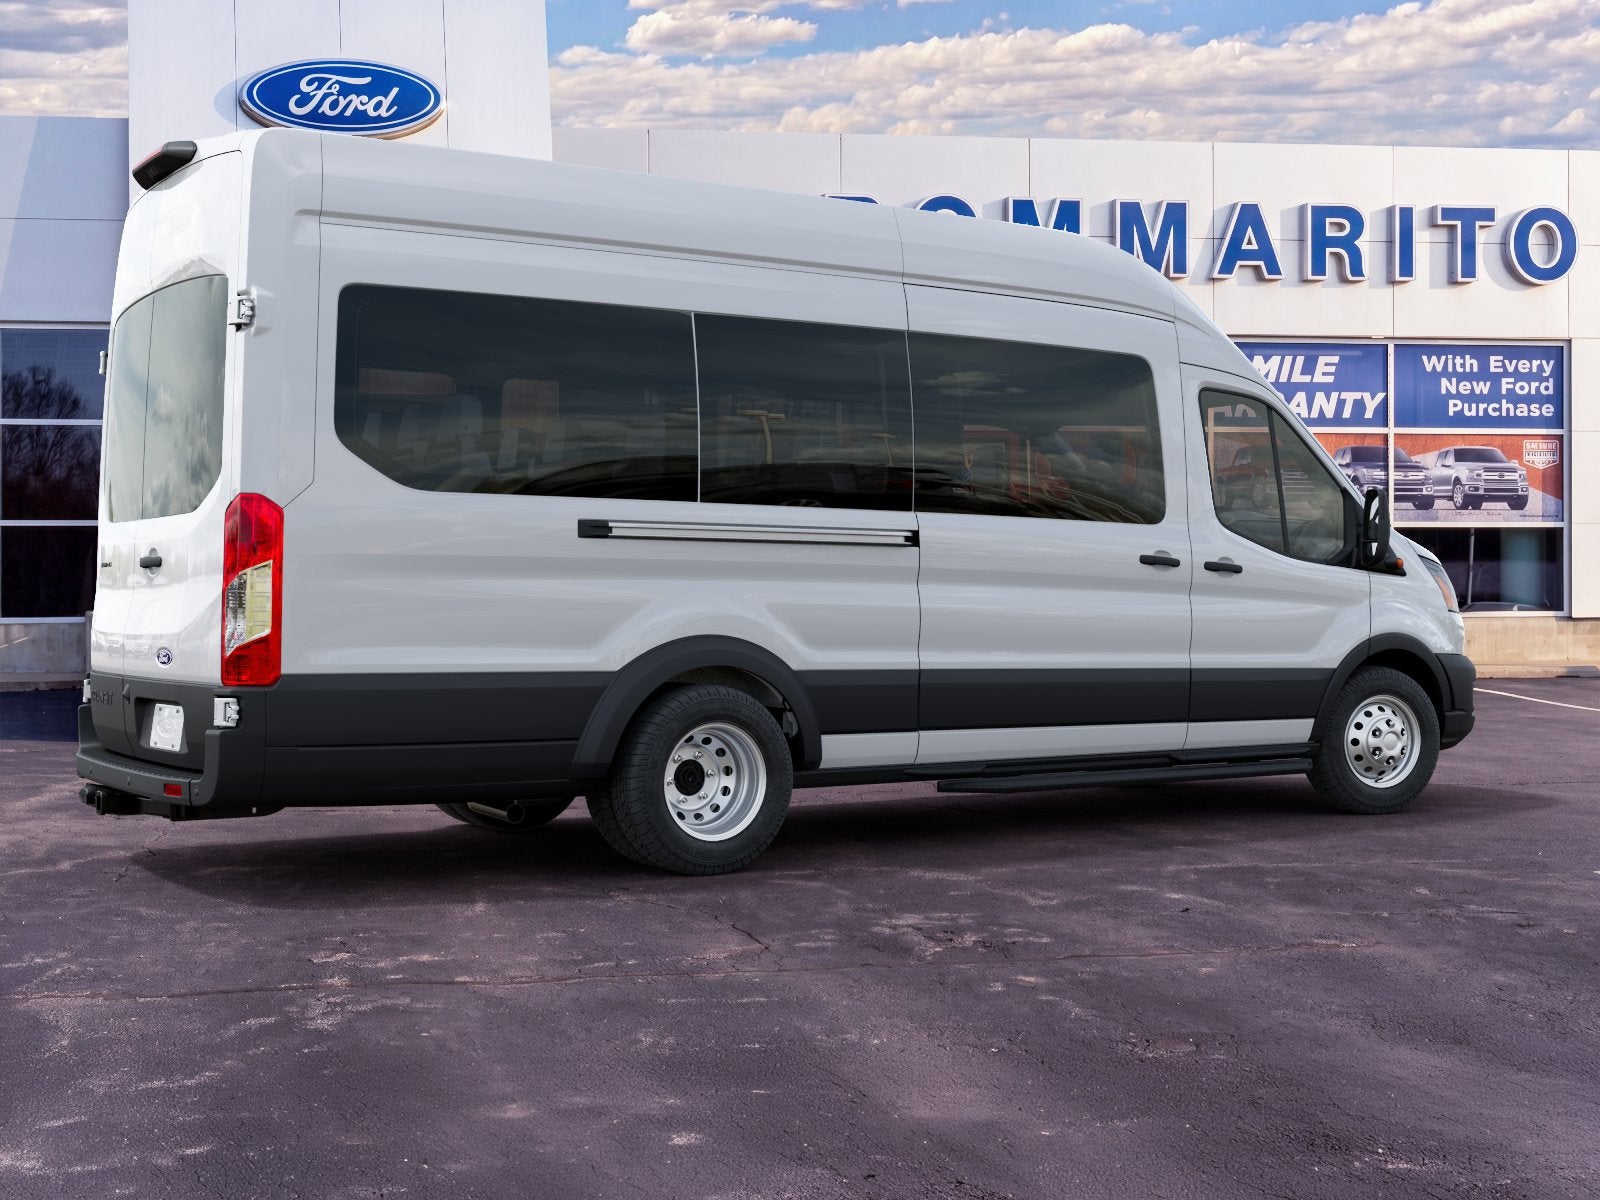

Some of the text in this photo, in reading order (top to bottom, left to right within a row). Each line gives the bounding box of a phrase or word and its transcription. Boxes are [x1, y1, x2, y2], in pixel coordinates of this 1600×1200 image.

[288, 73, 399, 118] Ford
[1252, 355, 1340, 383] MILE
[1421, 354, 1554, 377] With Every
[1440, 377, 1554, 395] New Ford
[1278, 391, 1386, 419] ANTY
[1448, 399, 1554, 418] Purchase
